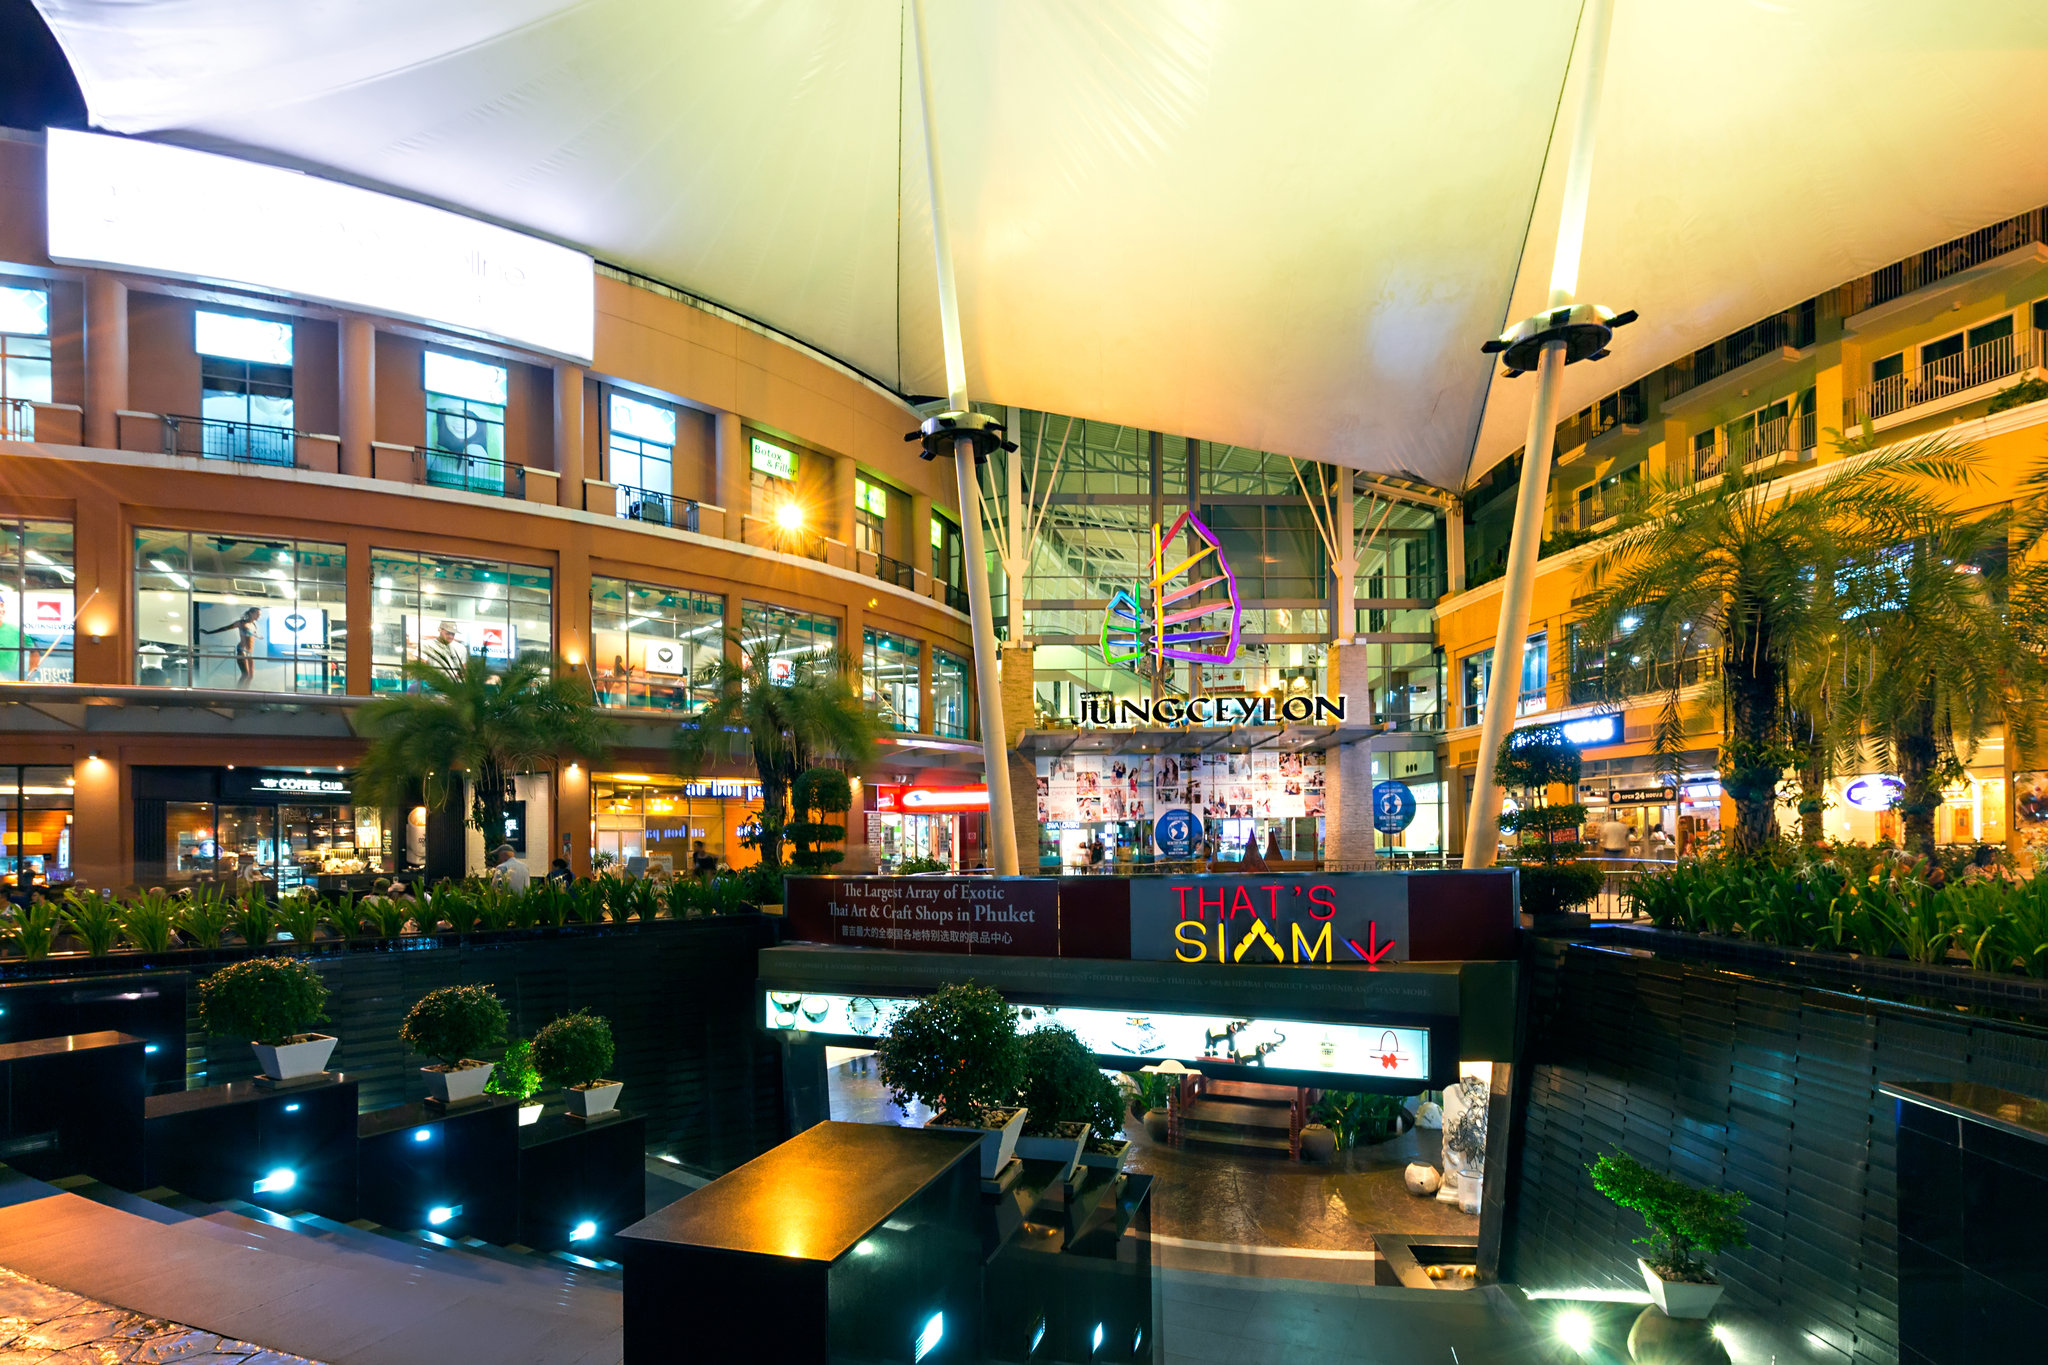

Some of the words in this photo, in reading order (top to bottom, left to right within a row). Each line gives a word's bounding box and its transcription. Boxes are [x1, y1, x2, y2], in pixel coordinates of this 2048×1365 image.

[754, 444, 782, 462] Botox
[766, 460, 773, 468] &
[774, 461, 797, 477] Filler
[279, 778, 321, 790] COFFEE
[321, 781, 344, 791] CLUB
[685, 783, 706, 797] au
[711, 780, 742, 797] bon
[1634, 792, 1646, 800] 24
[843, 882, 862, 897] The
[864, 883, 903, 902] Largest
[905, 884, 940, 904] Array
[943, 883, 959, 900] of
[960, 884, 1005, 900] Exotic
[828, 901, 849, 917] Thai
[850, 903, 867, 918] Art
[869, 905, 880, 918] &
[882, 904, 912, 920] Craft
[915, 905, 953, 925] Shops
[957, 907, 970, 922] in
[974, 904, 1036, 923] Phuket
[1174, 917, 1333, 964] SIAM
